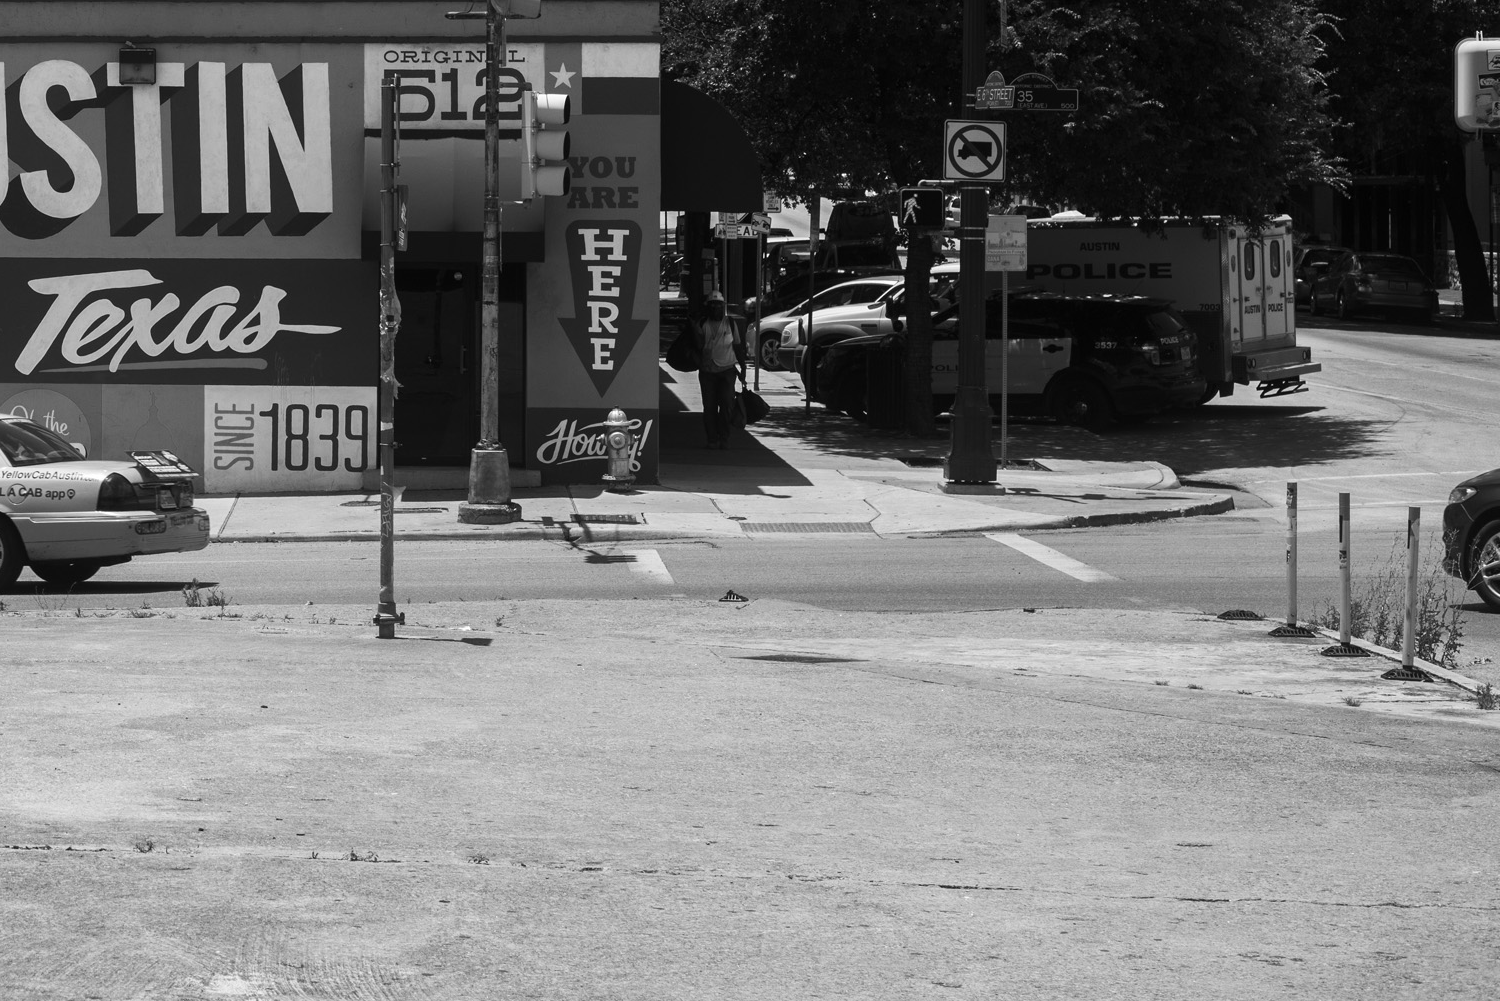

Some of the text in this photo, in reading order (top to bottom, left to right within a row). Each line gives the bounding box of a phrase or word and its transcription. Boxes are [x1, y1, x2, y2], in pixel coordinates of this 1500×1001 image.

[383, 50, 525, 64] ORIGINL
[383, 67, 525, 122] 512
[977, 89, 981, 101] E
[989, 88, 1013, 101] STREET
[568, 156, 636, 179] YOU
[567, 186, 639, 209] ARE
[1079, 242, 1120, 251] AUSTIN
[1026, 263, 1173, 280] POLICE
[578, 228, 630, 371] HERE
[1199, 303, 1220, 311] 7003
[1244, 303, 1283, 314] AUSTIN POLICE
[14, 267, 343, 376] Texas
[1094, 341, 1118, 349] 3537
[1160, 336, 1180, 346] POLICE
[43, 409, 70, 436] the
[213, 402, 255, 472] SINCE
[259, 402, 369, 473] 1839
[536, 418, 654, 472] Howy!
[7, 487, 16, 497] A
[18, 487, 42, 498] CAB
[45, 490, 65, 500] app
